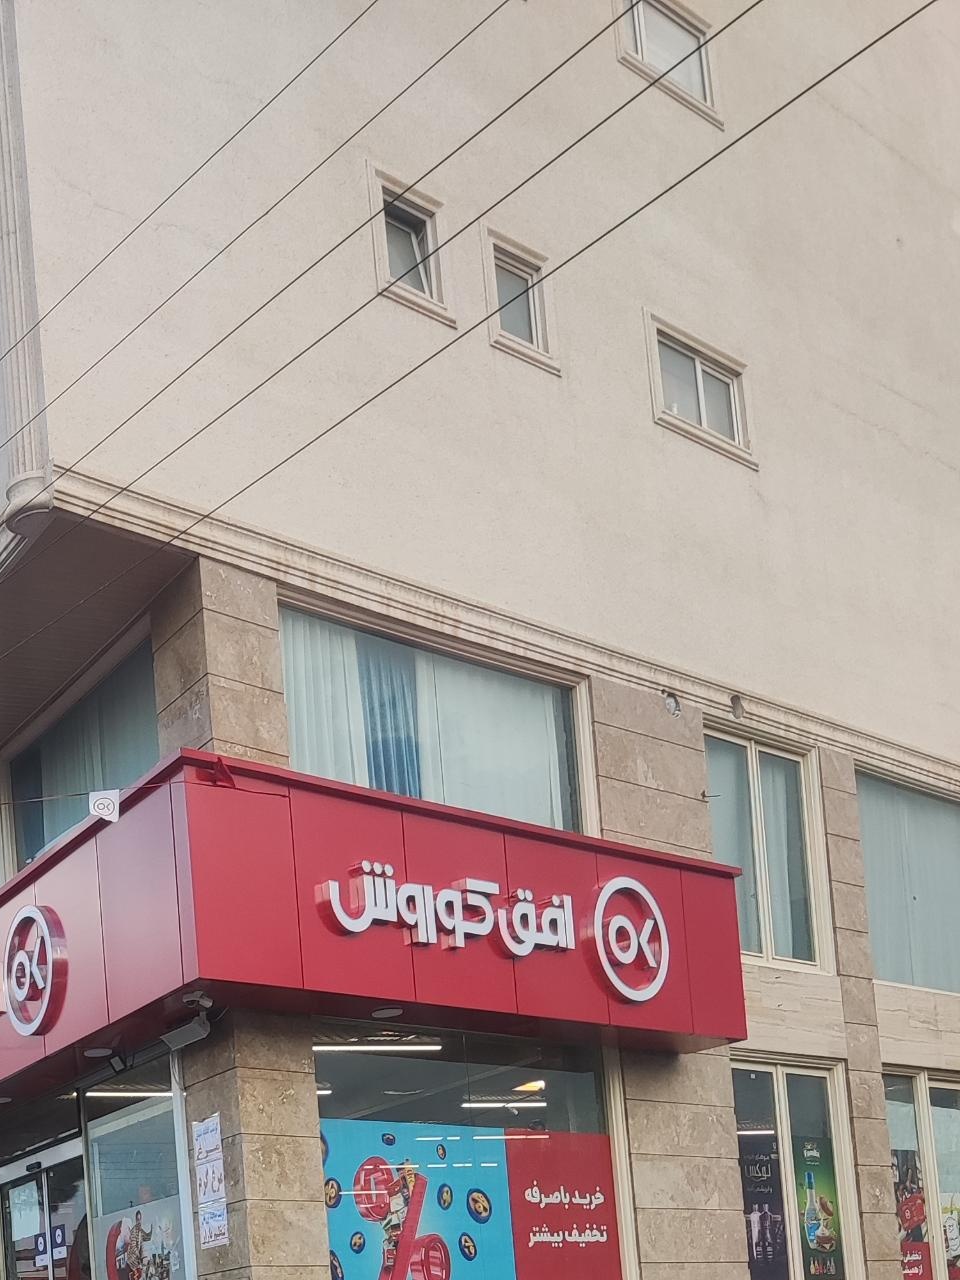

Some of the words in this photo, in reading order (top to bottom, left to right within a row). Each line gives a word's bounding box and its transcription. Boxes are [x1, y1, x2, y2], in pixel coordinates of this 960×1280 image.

[327, 860, 500, 949] کوروش
[497, 888, 576, 957] افق
[571, 1186, 605, 1209] خرید
[528, 1223, 563, 1248] بیشتر
[564, 1223, 608, 1247] تخفیف
